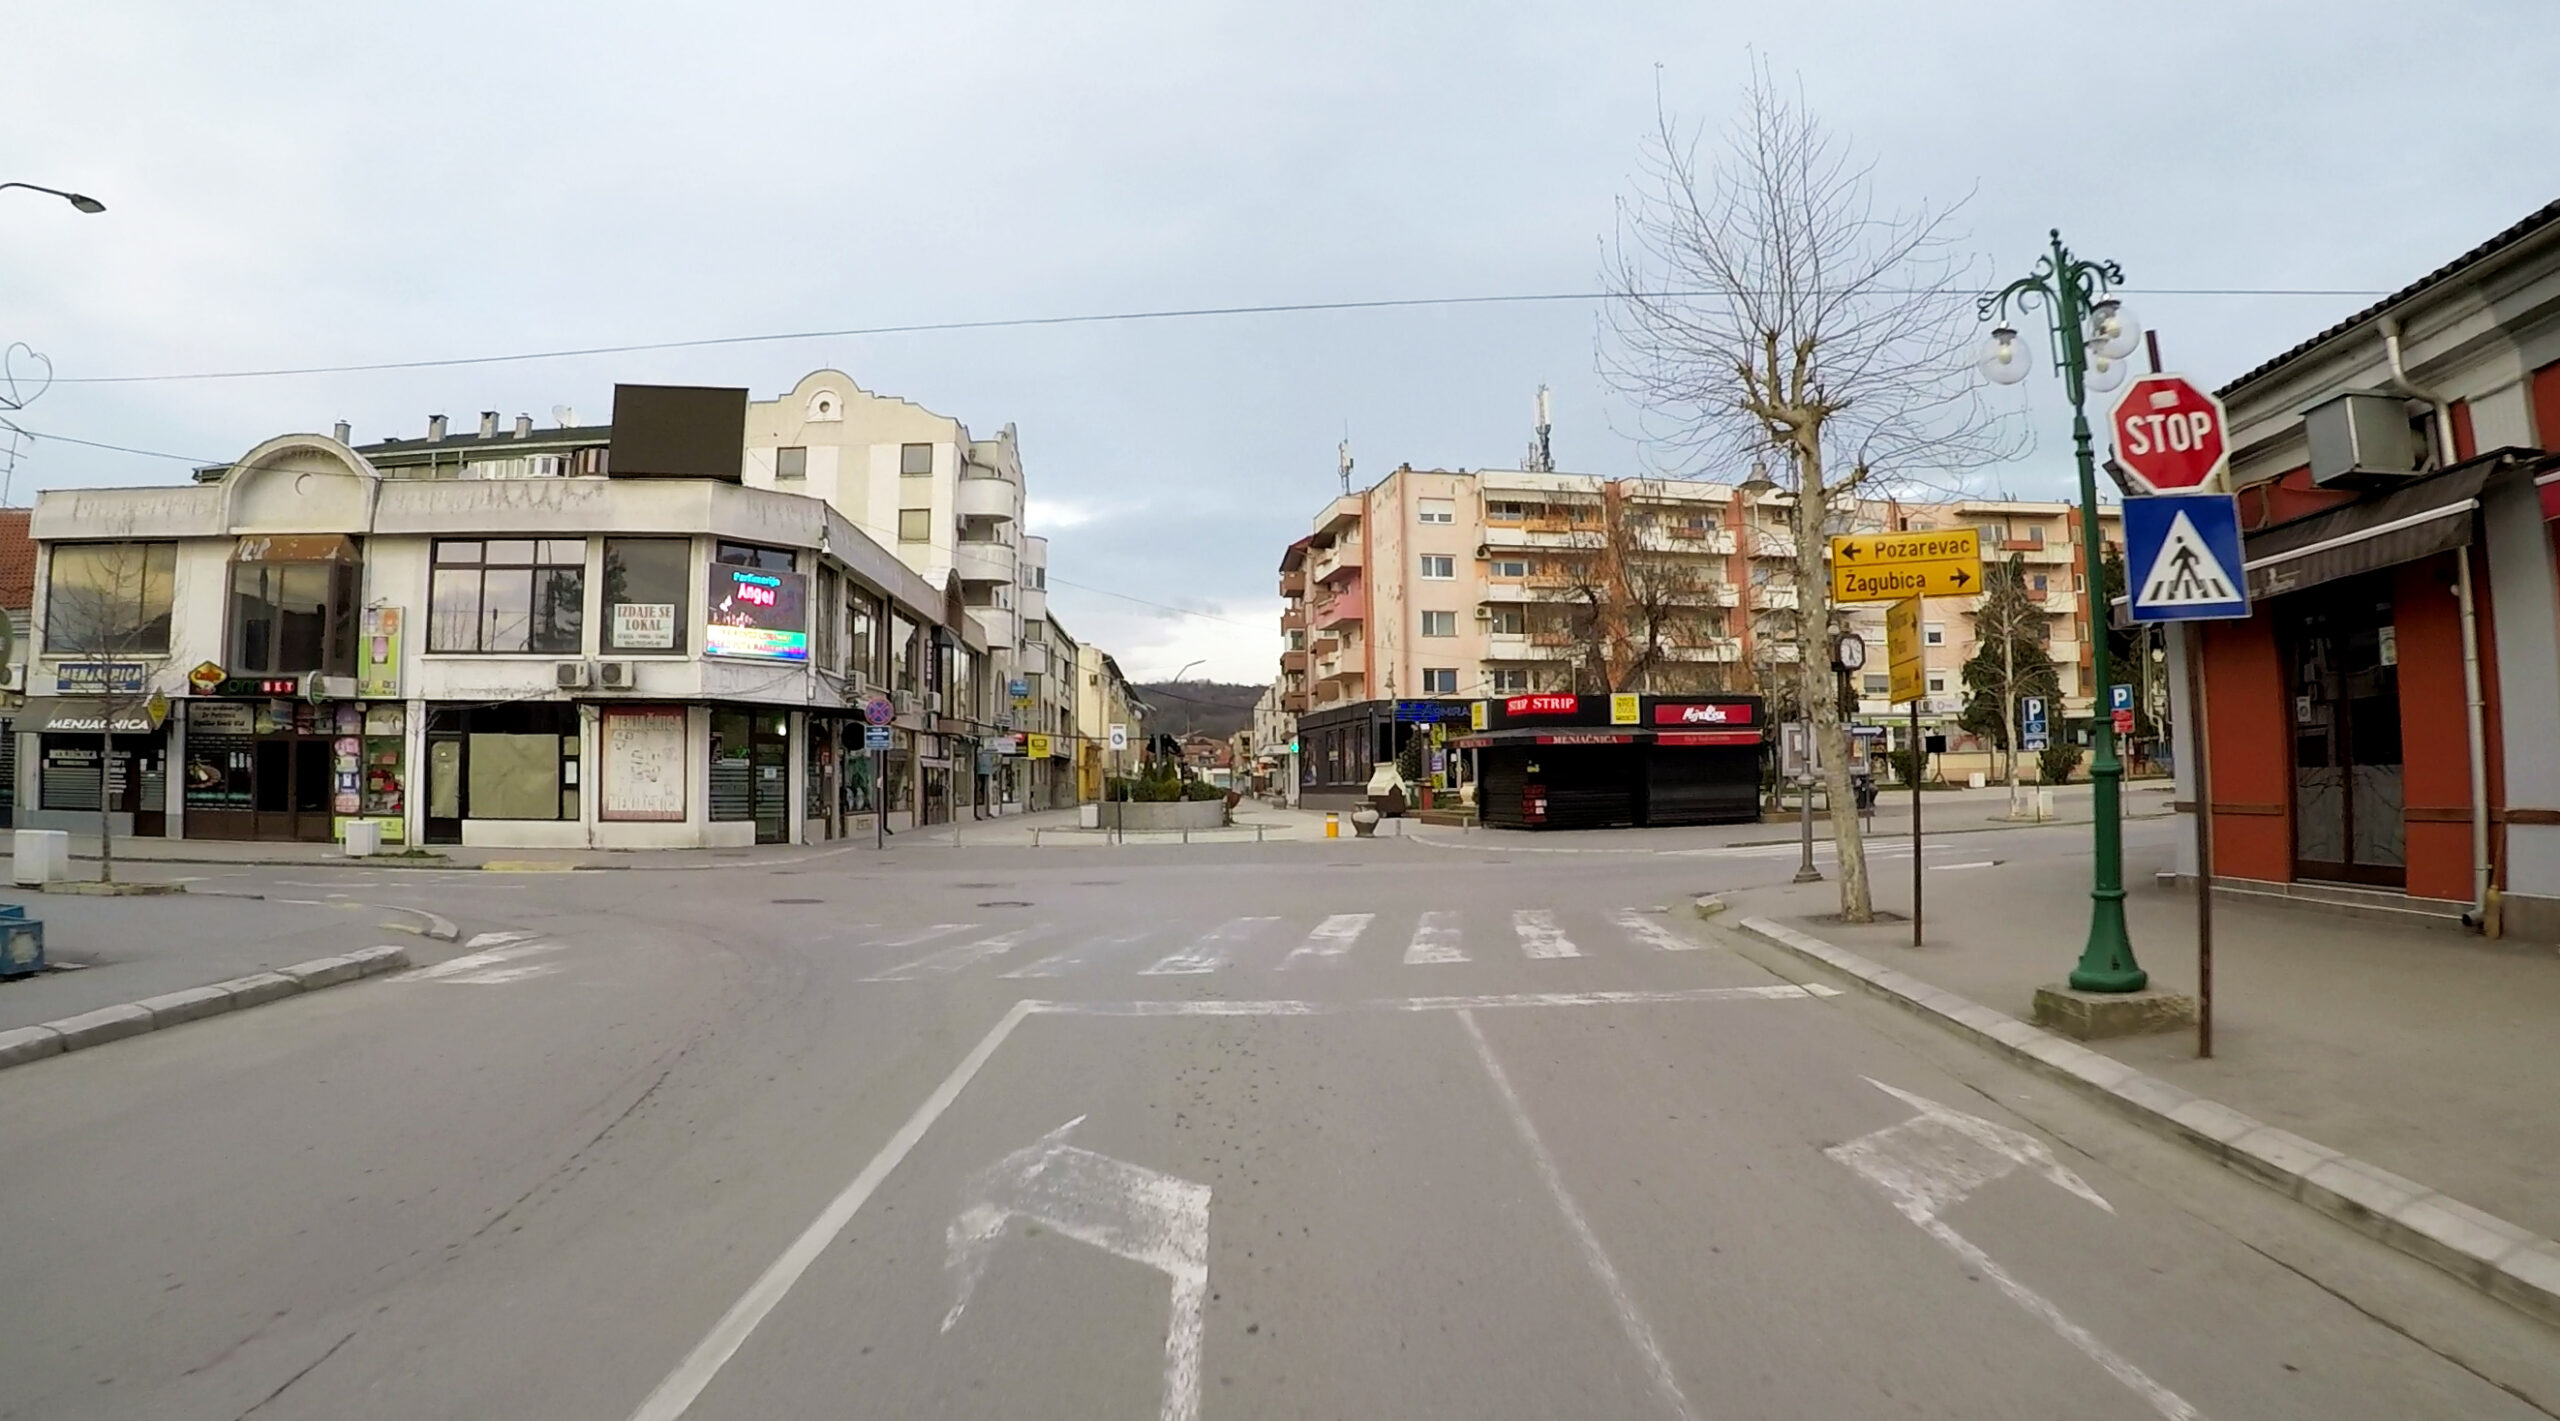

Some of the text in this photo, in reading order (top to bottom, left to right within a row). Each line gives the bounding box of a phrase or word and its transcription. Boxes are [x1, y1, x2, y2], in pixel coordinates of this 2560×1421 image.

[2125, 411, 2212, 456] STOP
[1845, 570, 1926, 596] Žagubica
[737, 583, 775, 605] Angel
[617, 606, 672, 618] IZDAJE SE
[625, 619, 662, 631] LOKAL
[1532, 698, 1575, 710] STRIP
[2113, 689, 2127, 707] P
[2028, 700, 2041, 720] P
[1553, 734, 1618, 744] MENJAČNICA
